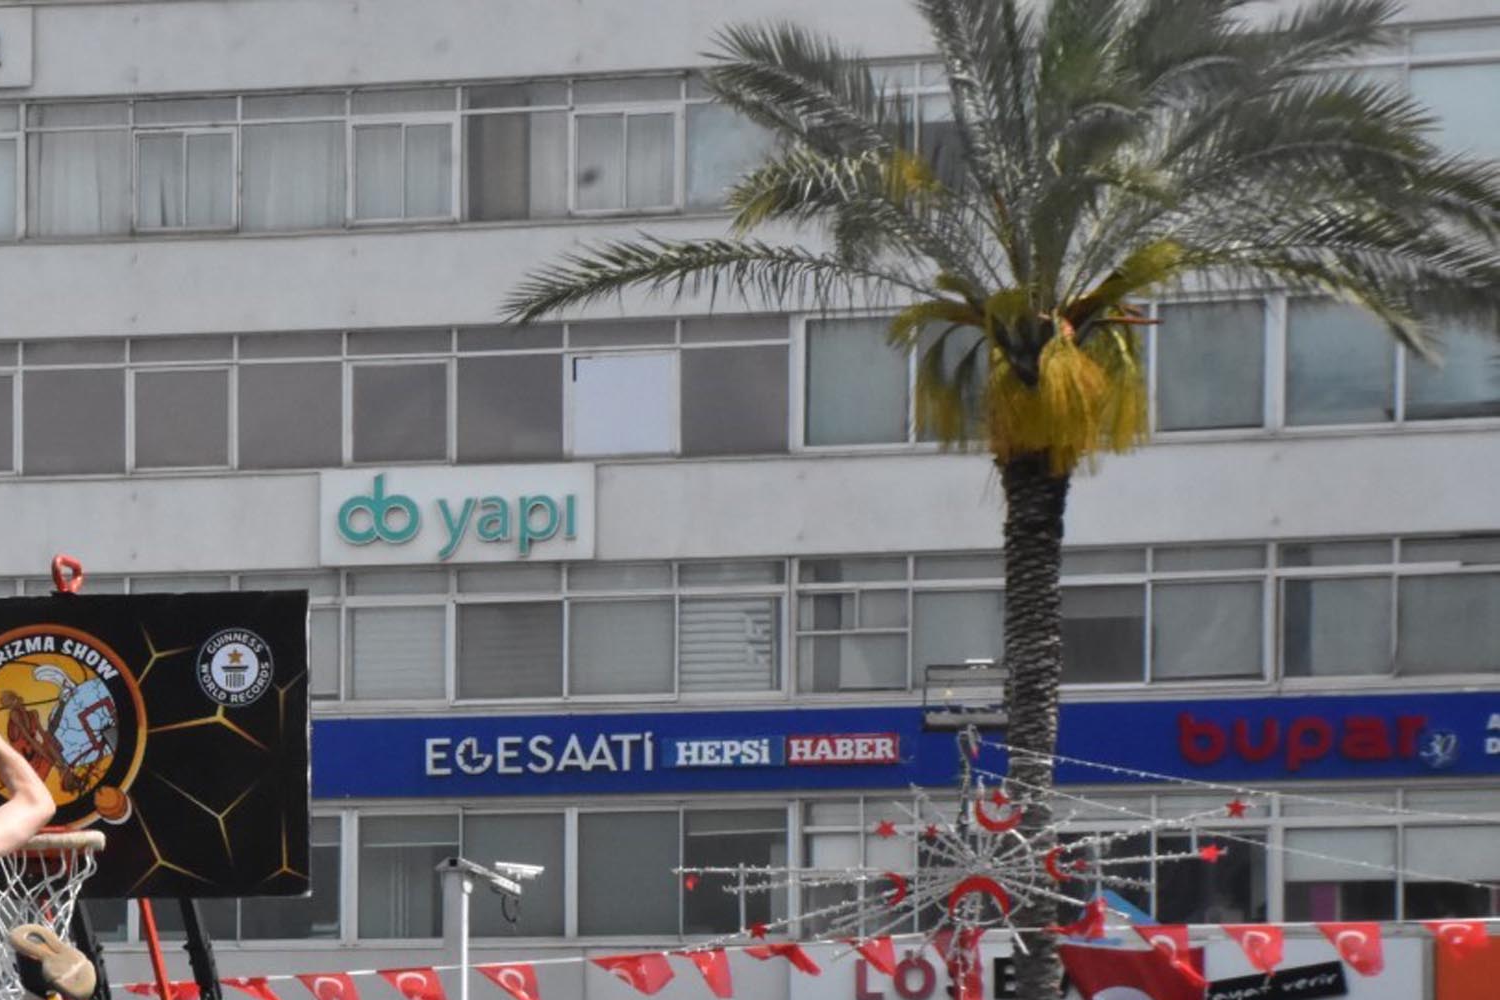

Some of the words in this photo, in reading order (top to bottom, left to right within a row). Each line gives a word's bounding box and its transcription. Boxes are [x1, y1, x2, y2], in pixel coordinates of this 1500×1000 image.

[436, 494, 577, 560] yapı
[61, 639, 119, 680] SHOW
[206, 632, 264, 655] GUINNESS
[201, 662, 228, 700] WORLD
[230, 661, 270, 703] RECORDS
[788, 736, 895, 762] HABER
[1177, 711, 1428, 771] bupar
